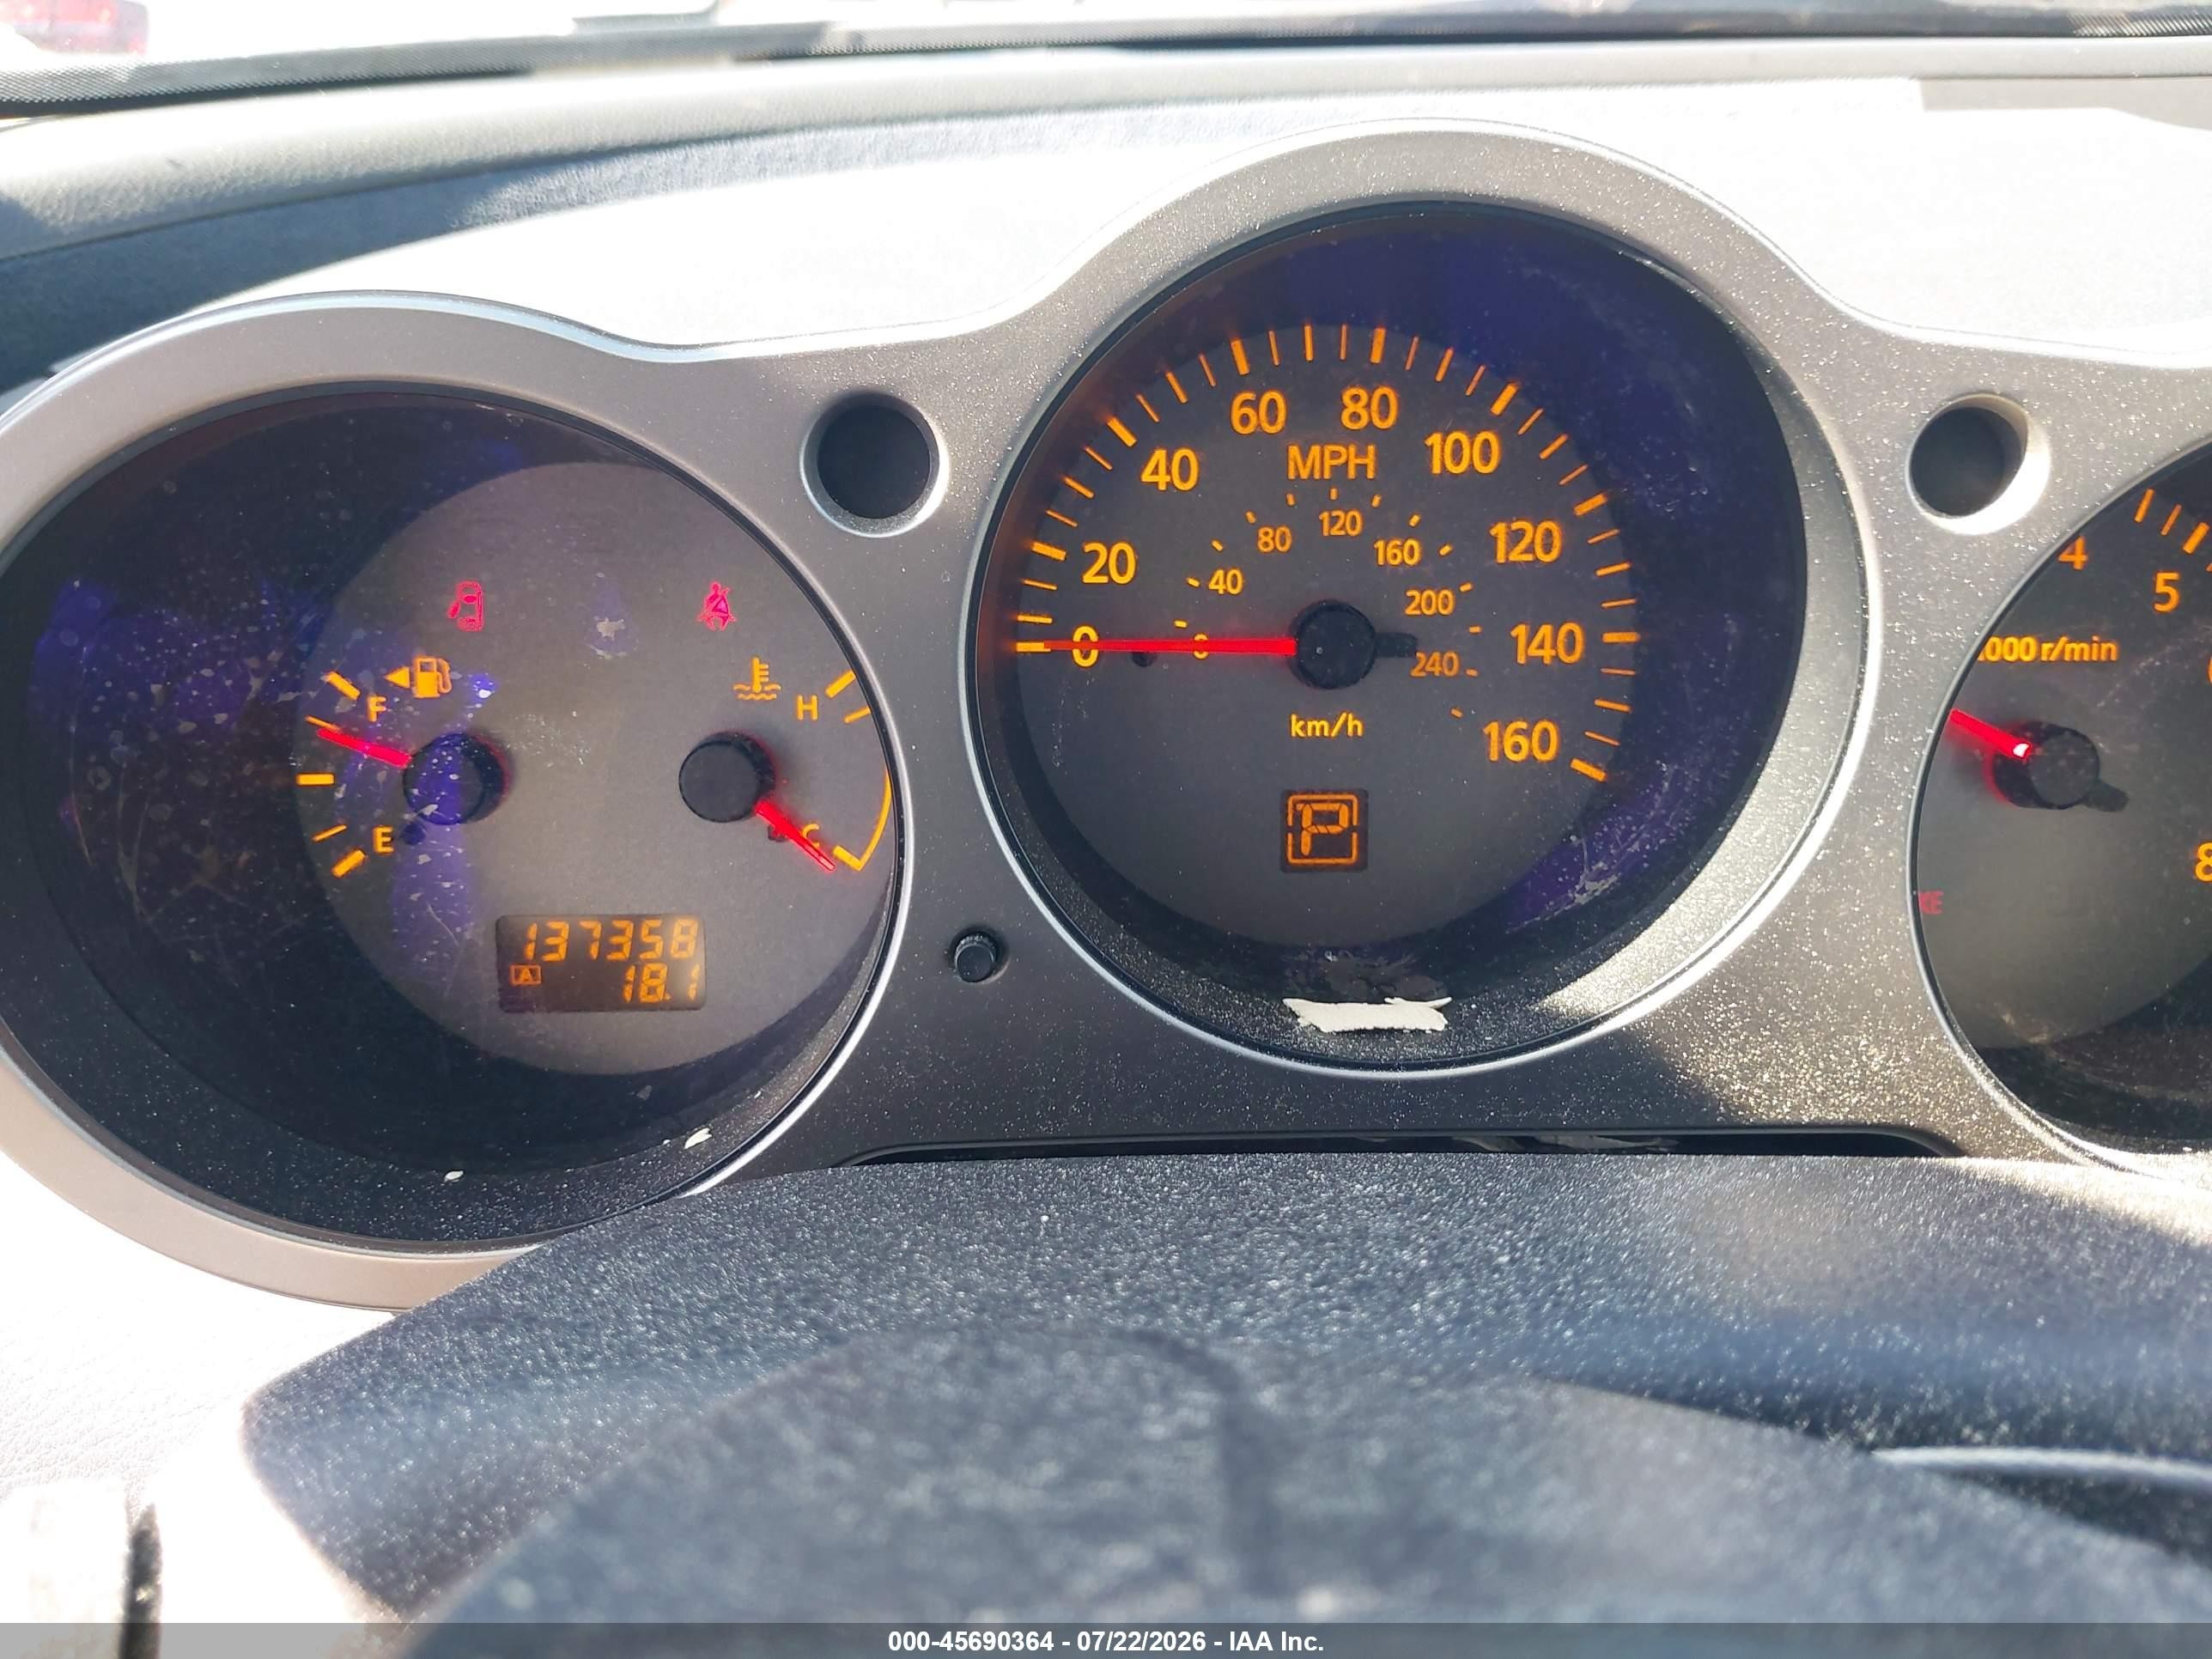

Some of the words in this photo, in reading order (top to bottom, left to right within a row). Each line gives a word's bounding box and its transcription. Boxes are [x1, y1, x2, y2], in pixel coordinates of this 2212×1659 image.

[1230, 389, 1288, 435] 60
[1340, 385, 1400, 430] 80
[1140, 447, 1200, 492] 40
[1287, 443, 1377, 480] MPH
[1424, 429, 1503, 476] 100
[1256, 525, 1292, 554] 80
[1317, 509, 1364, 537] 120
[1489, 519, 1564, 564] 120
[1081, 541, 1138, 586] 20
[1373, 537, 1423, 567] 160
[2058, 536, 2088, 570] 4
[1206, 567, 1245, 596] 40
[2153, 570, 2181, 613] 5
[1404, 587, 1456, 617] 200
[1072, 625, 1099, 668] 0
[1510, 622, 1586, 665] 140
[2040, 635, 2118, 662] r/min
[1410, 651, 1459, 678] 240
[367, 696, 386, 722] F
[795, 694, 818, 721] H
[1290, 711, 1364, 738] km/h
[1483, 720, 1559, 763] 160
[373, 826, 394, 854] E
[1297, 800, 1351, 857] P
[523, 919, 699, 963] 137358
[622, 962, 702, 1003] 18.1
